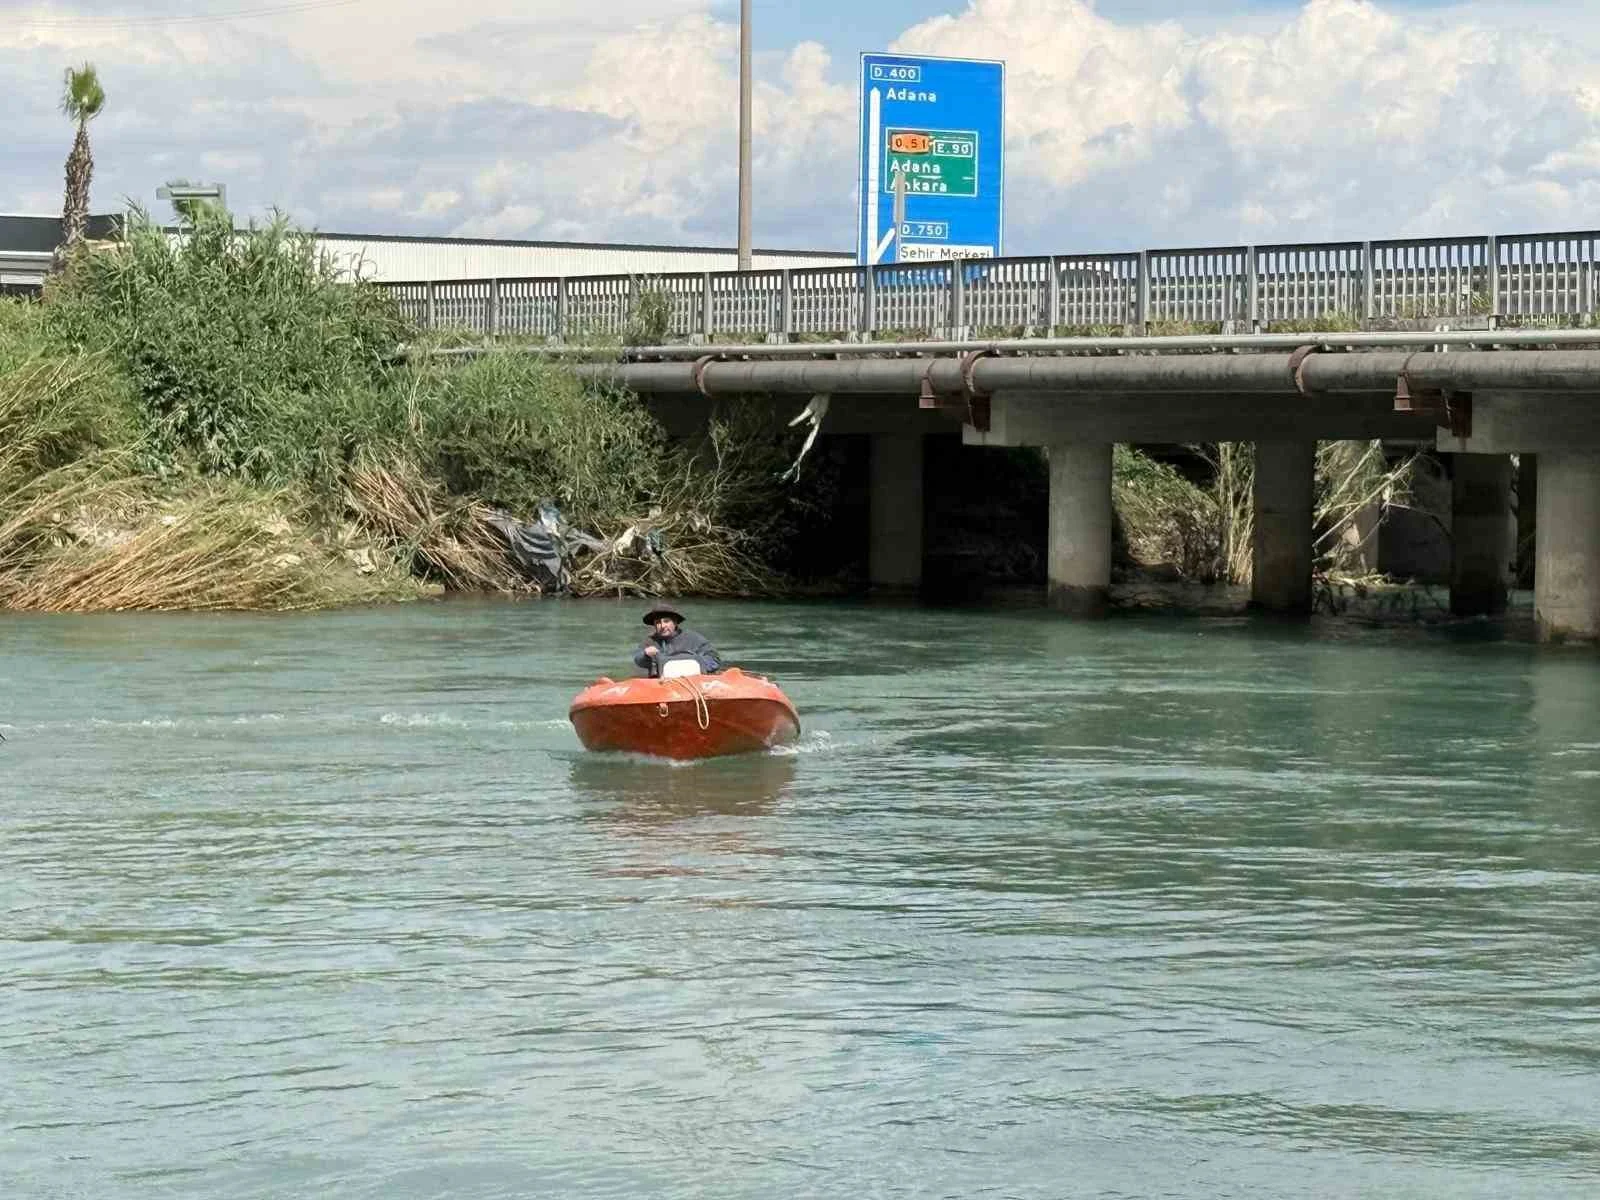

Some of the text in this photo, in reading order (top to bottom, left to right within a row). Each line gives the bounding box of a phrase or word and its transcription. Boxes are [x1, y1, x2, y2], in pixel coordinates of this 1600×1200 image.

[874, 67, 916, 79] D.400
[886, 88, 937, 102] Adana
[937, 144, 969, 154] E.90
[890, 160, 941, 173] Adana
